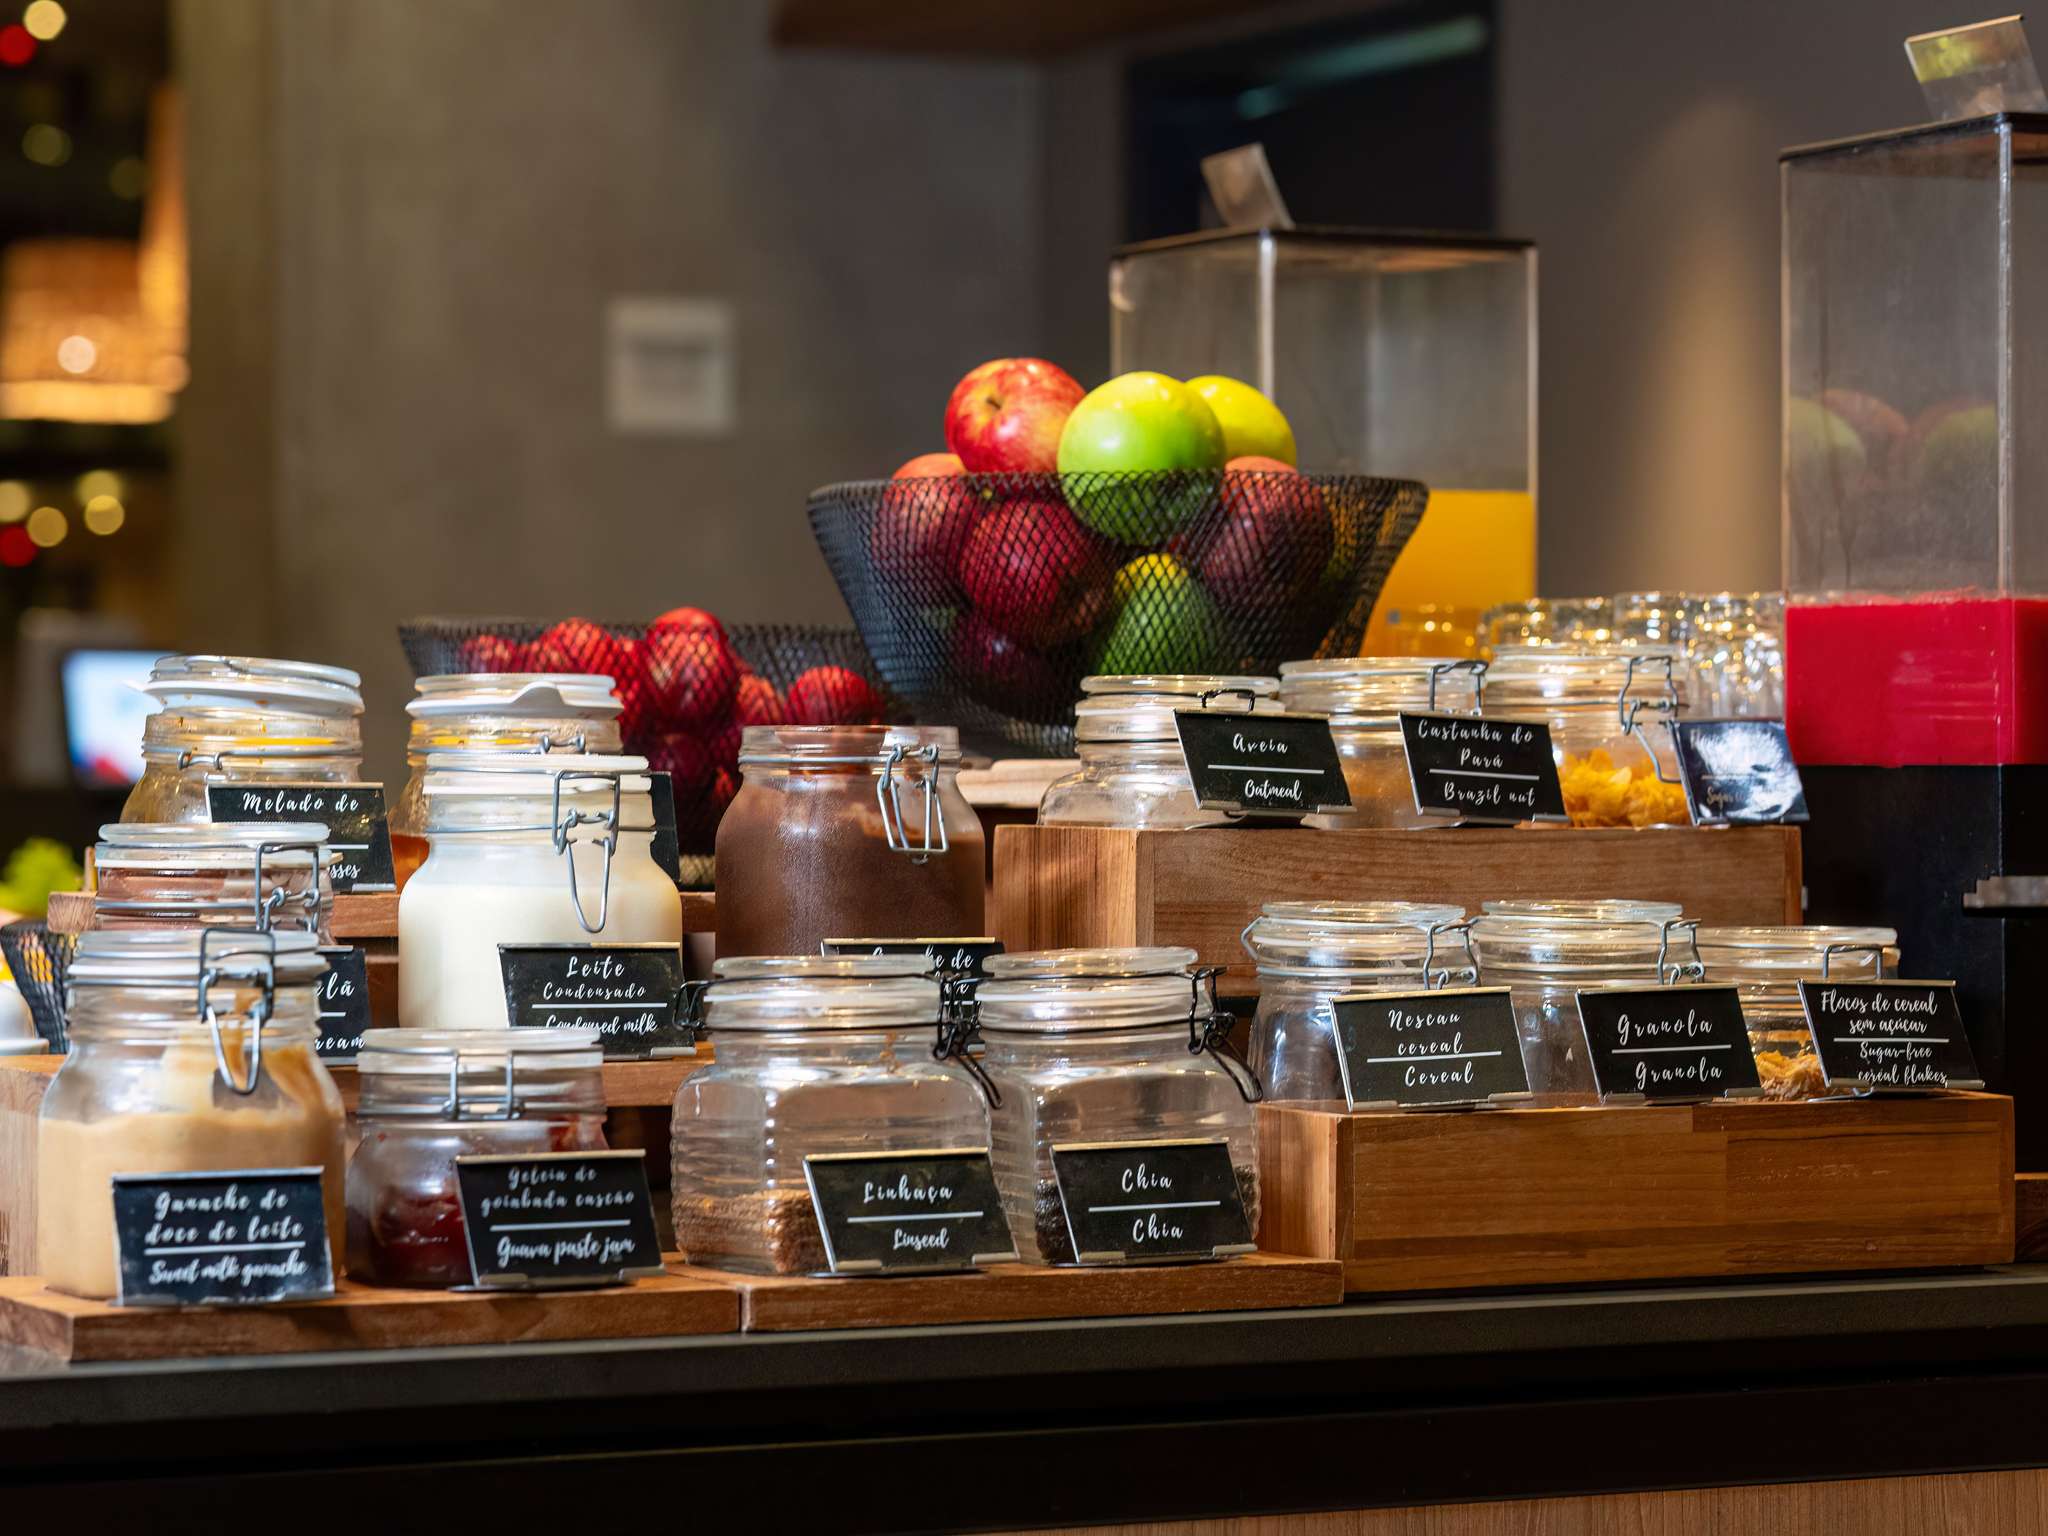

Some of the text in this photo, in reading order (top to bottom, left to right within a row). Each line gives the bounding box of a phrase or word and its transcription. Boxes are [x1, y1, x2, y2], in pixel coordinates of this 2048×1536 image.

[1232, 732, 1288, 754] Aveia
[1418, 719, 1534, 745] Castanha do
[1460, 747, 1504, 768] Pará
[1244, 779, 1302, 801] Oatmeal
[1443, 781, 1536, 807] Brazil nut
[242, 790, 359, 815] Melado de
[566, 955, 625, 979] Leite
[951, 947, 974, 970] de
[543, 982, 647, 1001] Condensado
[1820, 988, 1938, 1015] Flocos de cereal
[623, 1012, 659, 1036] milk
[1388, 1009, 1461, 1032] Nescau
[1617, 1008, 1713, 1046] Granola
[1849, 1018, 1928, 1035] sem açúcar
[314, 1036, 367, 1051] ream
[1397, 1032, 1464, 1055] cereal
[1859, 1041, 1933, 1063] Sugar-free
[1404, 1060, 1474, 1087] Cereal
[1635, 1056, 1722, 1090] Granola
[1858, 1063, 1947, 1085] cereal flakes
[574, 1165, 597, 1182] de
[1121, 1163, 1172, 1193] Chia
[260, 1188, 288, 1211] de
[863, 1174, 953, 1204] Linhaça
[144, 1215, 304, 1246] doce de leite
[892, 1227, 949, 1250] Linseed
[1132, 1213, 1184, 1243] Chia
[497, 1231, 636, 1268] Guava paste jam
[149, 1258, 200, 1285] Sweet
[201, 1255, 241, 1282] milk
